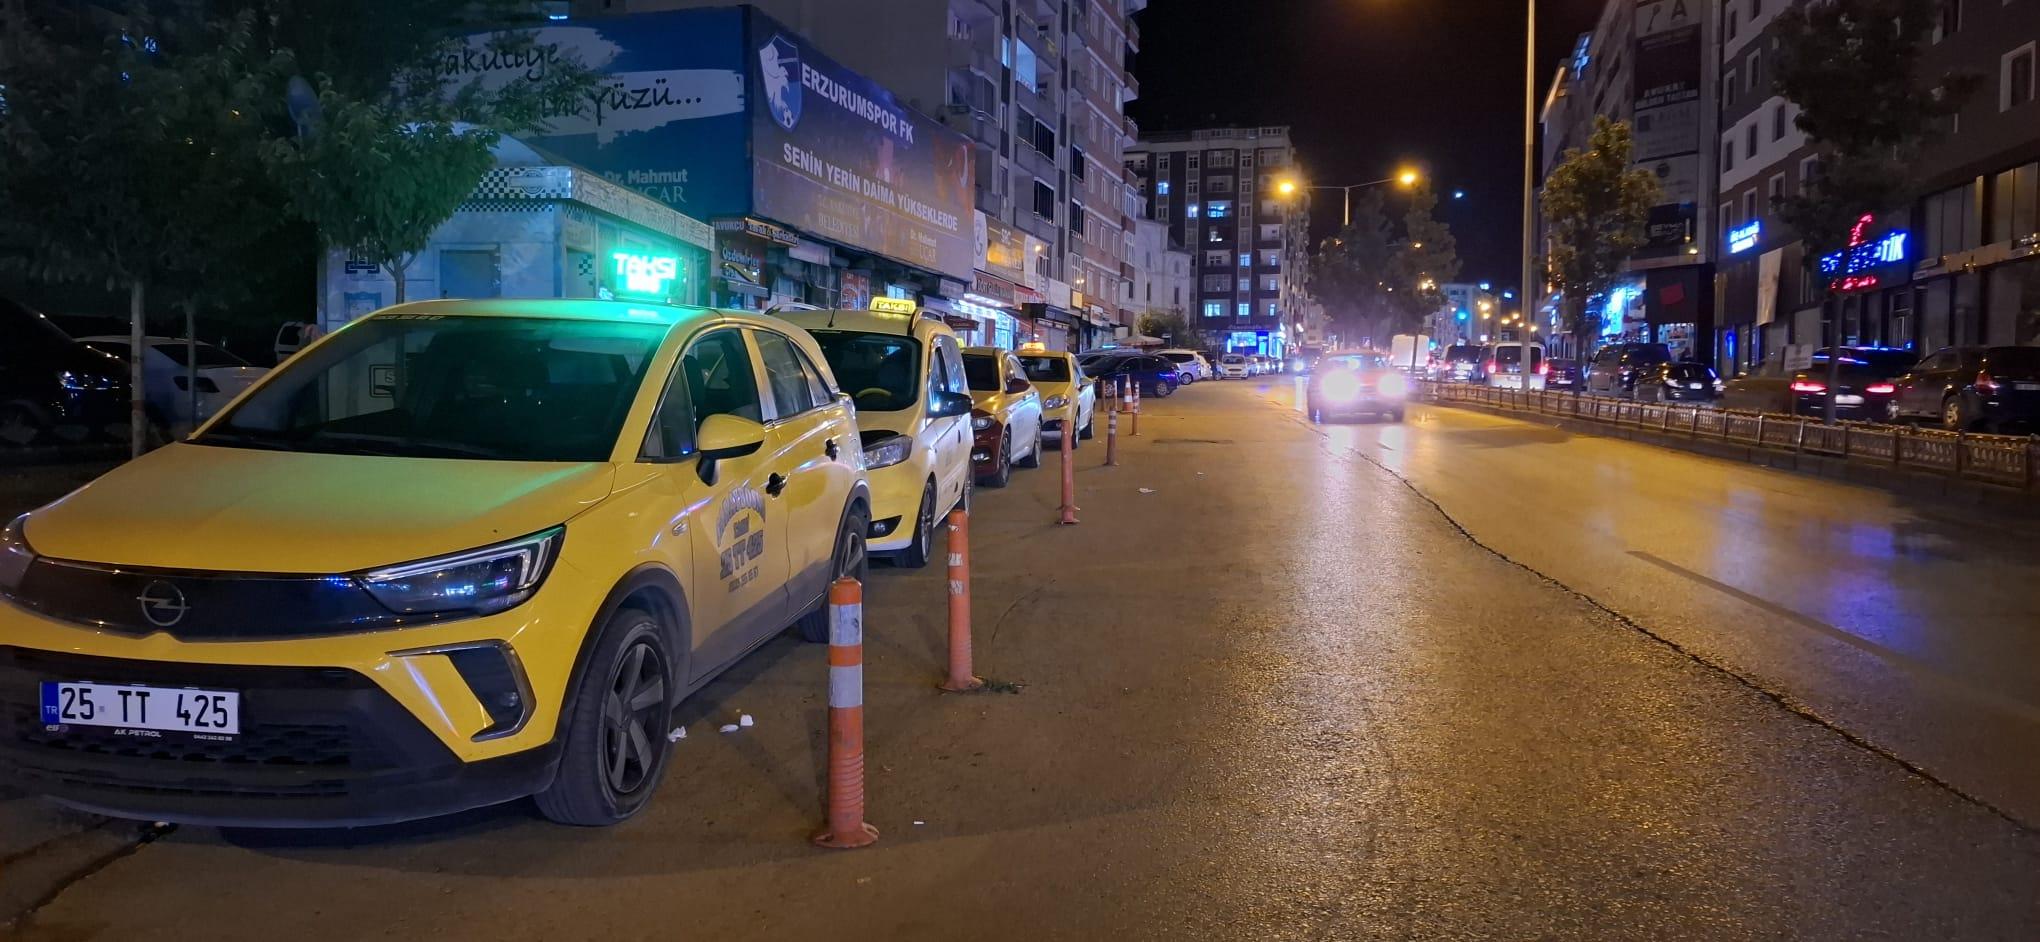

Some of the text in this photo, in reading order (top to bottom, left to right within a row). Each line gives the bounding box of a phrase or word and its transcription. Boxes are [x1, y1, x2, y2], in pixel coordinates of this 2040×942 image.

[801, 63, 914, 145] ERZURUMSPOR FK
[627, 168, 689, 184] Mahmut
[783, 142, 959, 233] SENİN YERİN DAİMA YÜKSEKLERDE
[46, 705, 58, 715] TR
[61, 687, 228, 728] 25 TT 425
[128, 729, 162, 738] PETROL
